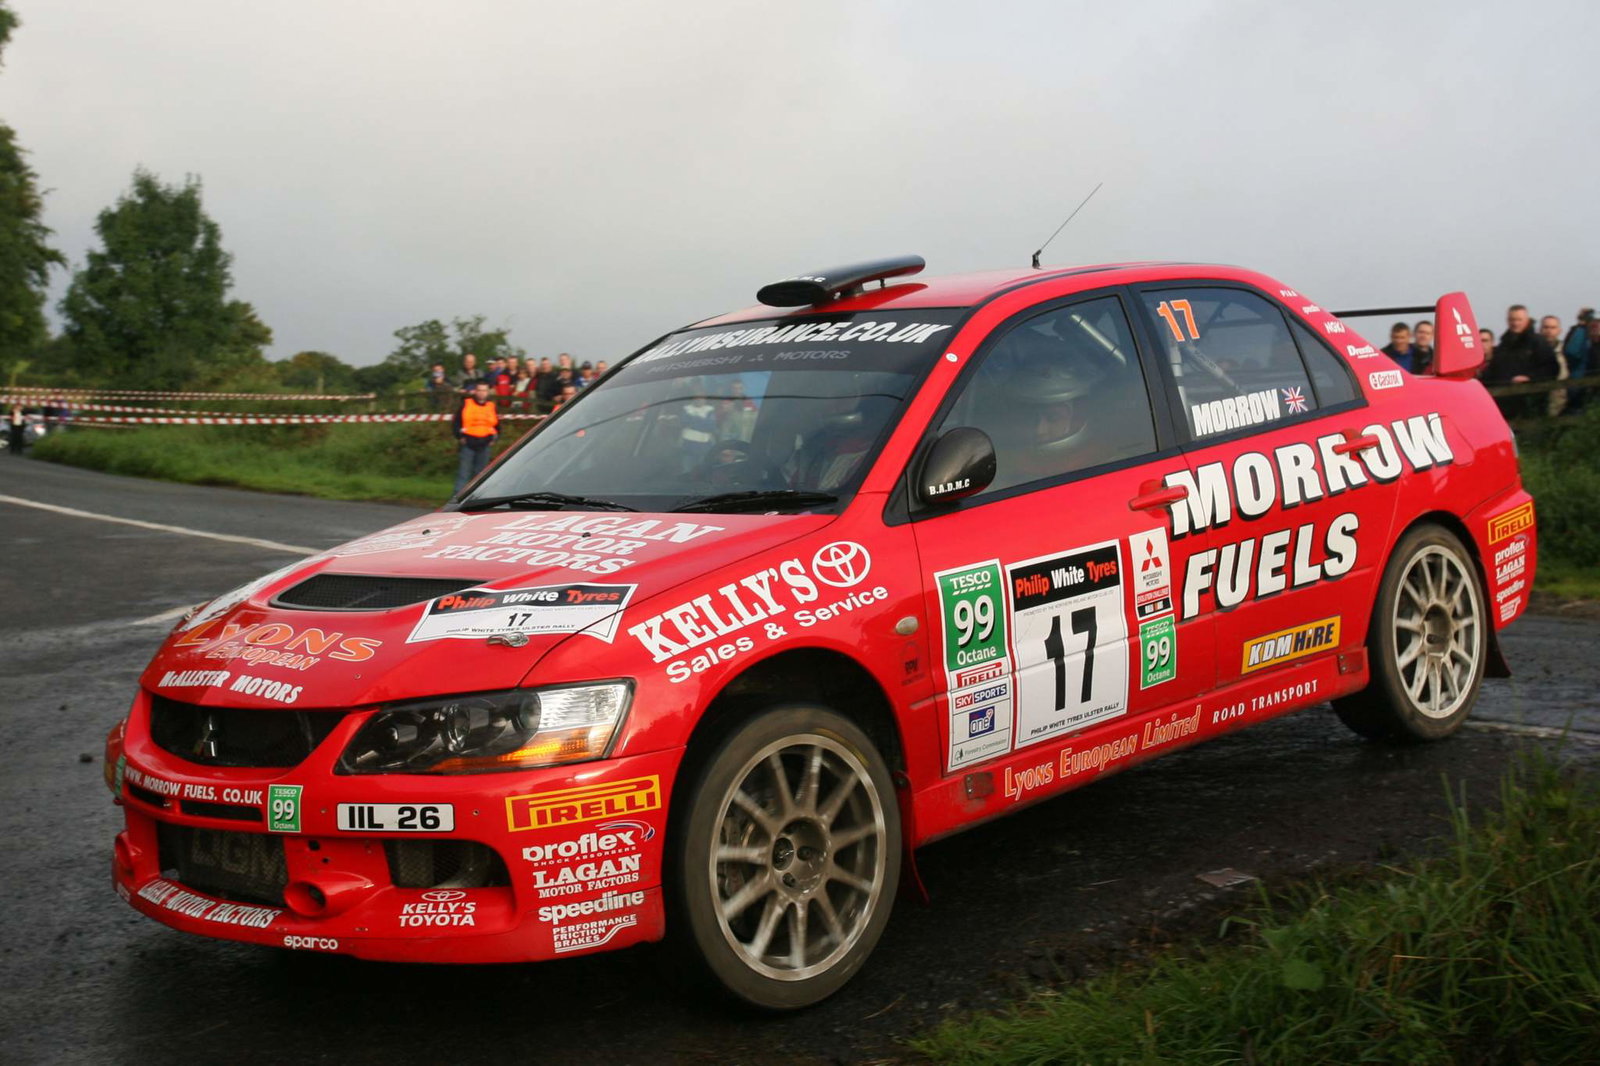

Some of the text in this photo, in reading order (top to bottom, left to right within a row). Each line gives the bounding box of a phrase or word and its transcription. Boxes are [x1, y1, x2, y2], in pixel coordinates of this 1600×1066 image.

[1156, 299, 1200, 342] 17
[774, 349, 851, 362] MOTORS
[1191, 388, 1281, 437] MORROW
[1164, 411, 1455, 537] MORROW
[495, 514, 726, 544] LAGAN
[1489, 505, 1533, 542] PIRELLI
[487, 531, 648, 557] MOTOR
[422, 545, 637, 575] FACTORS
[1182, 512, 1360, 622] FUELS
[950, 571, 991, 590] TESCO
[1015, 561, 1117, 599] Philip White Tyres
[438, 589, 621, 610] Philip White Tyres
[627, 558, 819, 664] KELLY'S
[507, 613, 534, 627] 17
[666, 586, 889, 684] Sales & Service
[953, 594, 995, 647] 99
[956, 644, 997, 666] Octane
[1043, 605, 1098, 712] 17
[1147, 637, 1171, 670] 99
[229, 675, 304, 705] MOTORS
[955, 662, 1003, 689] PIRELLI
[1147, 668, 1171, 683] Octane
[956, 684, 1007, 708] SKY SPORTS
[1212, 679, 1319, 724] ROAD TRANSPORT
[1030, 702, 1120, 735] PHILIP WHITE TYRES ULSTER RALLY
[144, 774, 182, 796] MORROW
[222, 788, 263, 805] CO.UK
[509, 777, 660, 830] PIRELLI
[273, 799, 295, 820] 99
[348, 806, 441, 829] IIL 26
[522, 830, 636, 862] proflex
[533, 845, 637, 867] SHOCK ABSORBERS
[532, 854, 642, 889] LAGAN
[539, 872, 639, 899] MOTOR FACTORS
[164, 891, 216, 919] MOTOR
[204, 903, 283, 929] FACTORS
[399, 914, 475, 927] TOYOTA
[402, 902, 476, 915] KELLY'S
[538, 889, 645, 925] speedline
[553, 914, 637, 935] PERFORMANCE
[553, 927, 606, 941] FRICTION
[283, 934, 339, 950] sparco
[554, 934, 600, 949] BRAKES
